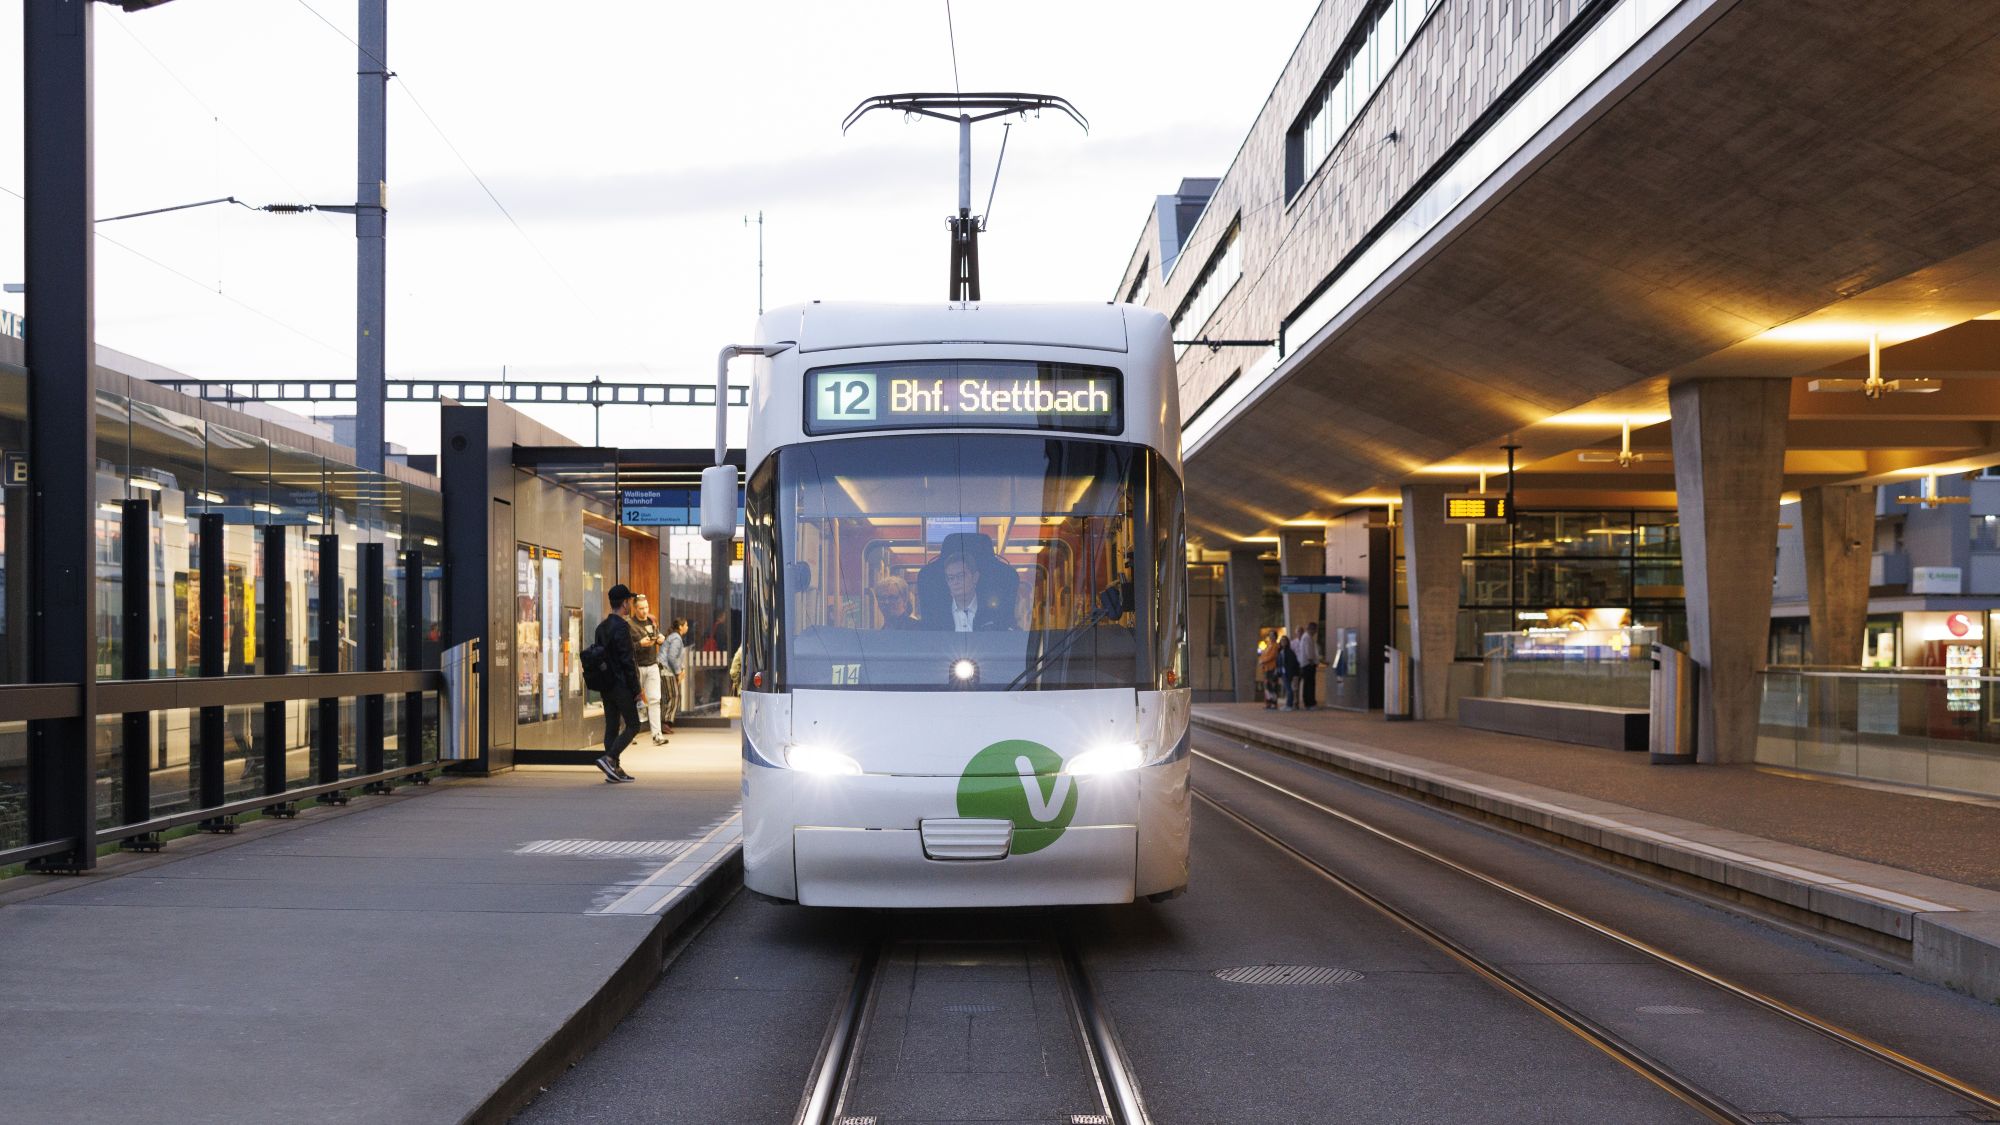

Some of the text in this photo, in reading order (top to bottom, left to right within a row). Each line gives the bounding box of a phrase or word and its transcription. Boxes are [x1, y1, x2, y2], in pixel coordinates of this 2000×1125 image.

[825, 379, 1109, 415] 12 Bhf. Stettbach
[626, 511, 640, 521] 12
[833, 665, 859, 685] 14
